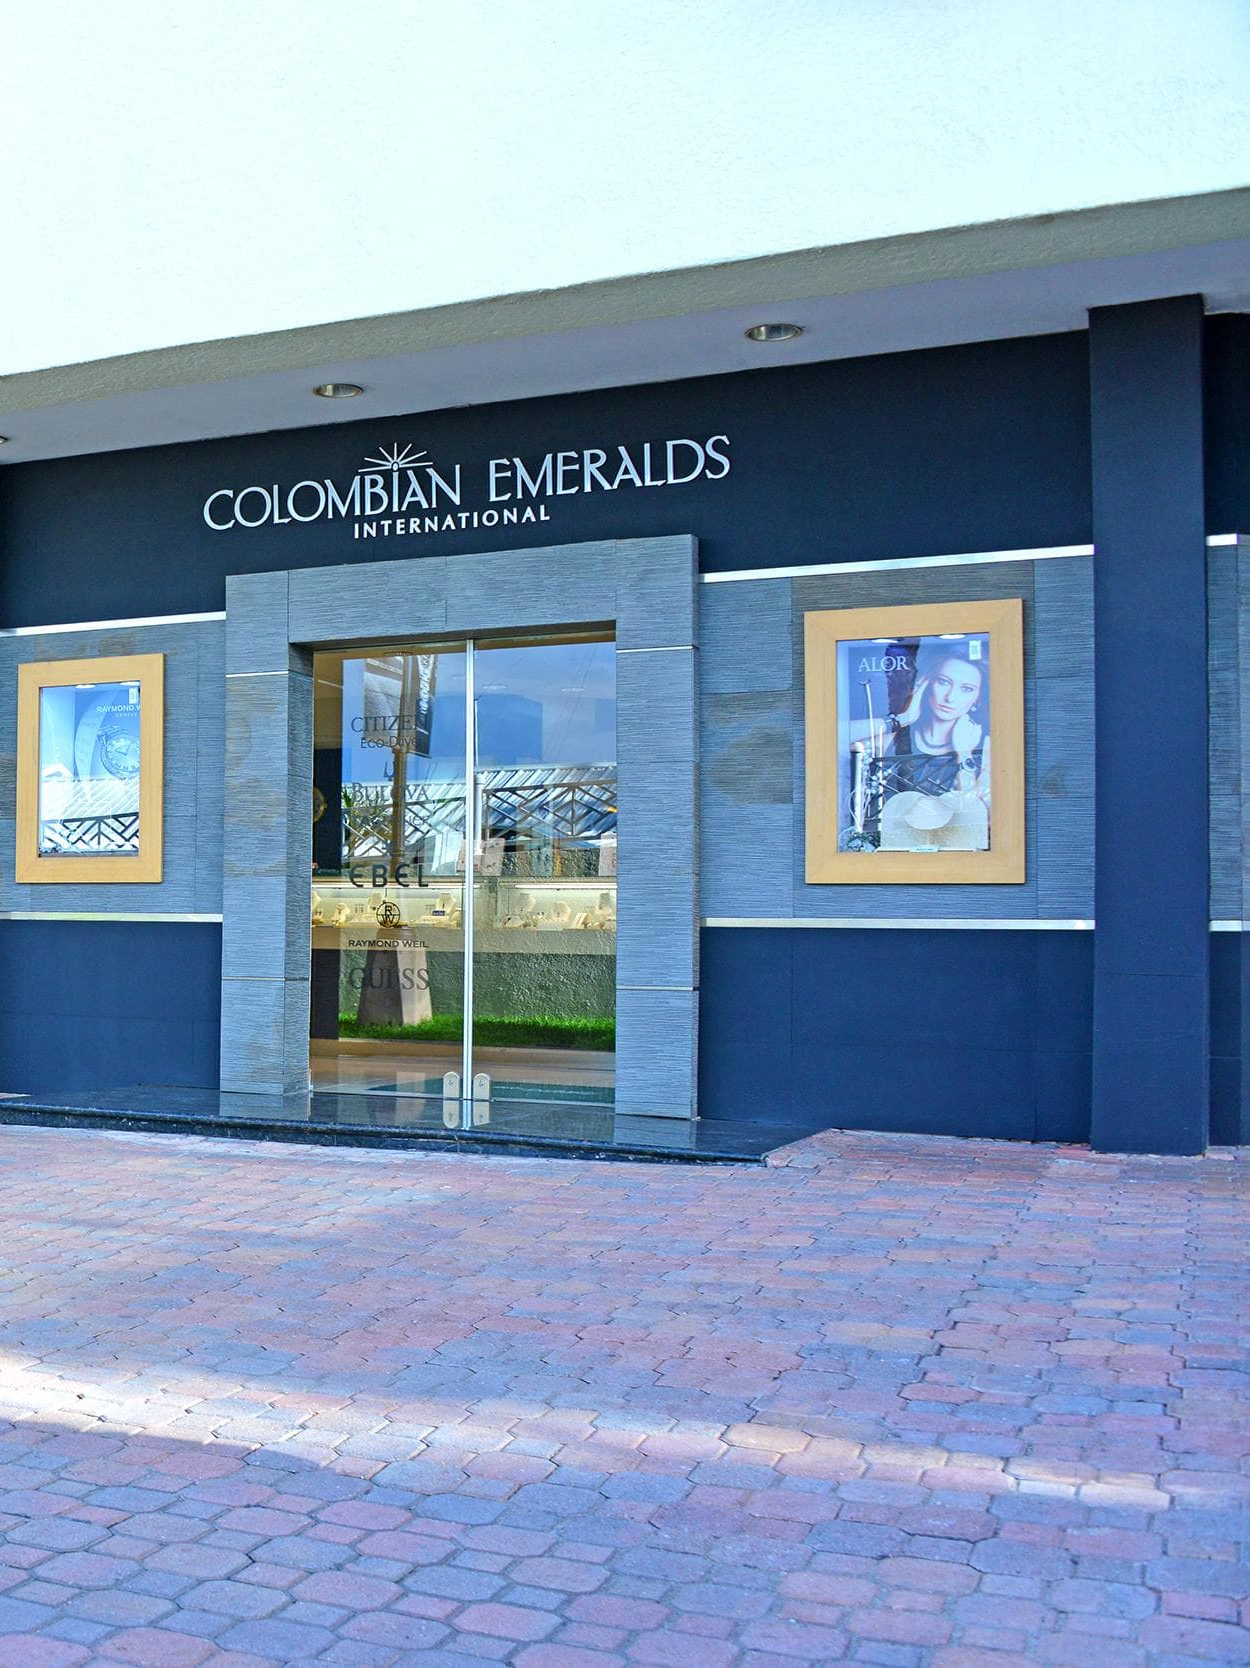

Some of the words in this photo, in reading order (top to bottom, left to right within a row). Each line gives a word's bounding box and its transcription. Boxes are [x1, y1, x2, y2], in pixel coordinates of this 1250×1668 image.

[204, 464, 461, 530] COLOMBIAN
[489, 435, 731, 503] EMERALDS
[354, 504, 550, 539] INTERNATIONAL
[858, 655, 910, 673] ALOR
[96, 704, 136, 713] RAYMOND
[351, 714, 429, 733] CITIZE
[349, 863, 430, 888] EBEL
[348, 939, 400, 949] RAYMOND
[402, 940, 430, 949] WEIL
